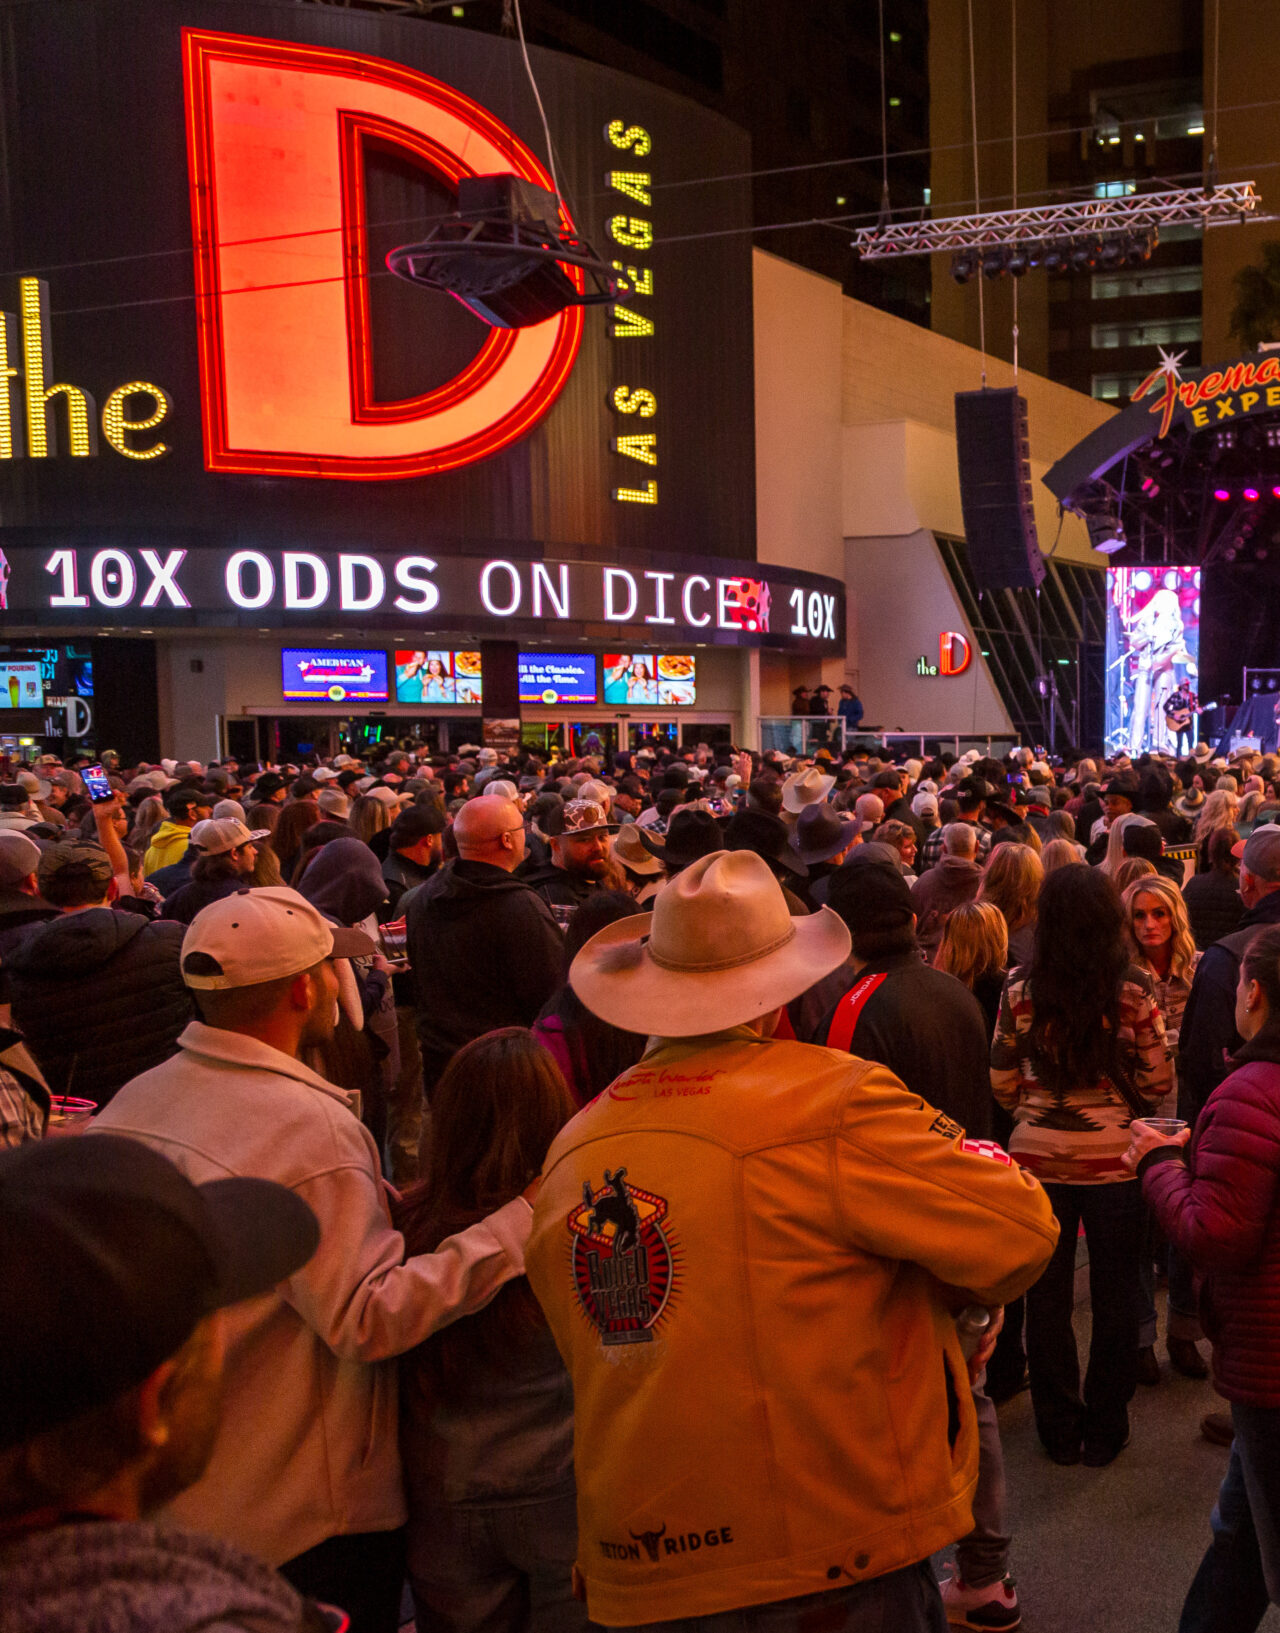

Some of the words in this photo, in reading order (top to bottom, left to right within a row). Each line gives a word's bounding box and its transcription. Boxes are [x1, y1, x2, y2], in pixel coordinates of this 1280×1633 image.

[606, 119, 655, 337] VEGAS
[0, 277, 169, 460] the
[181, 26, 585, 481] D
[612, 384, 658, 505] LAS
[45, 548, 192, 608] 10X
[225, 550, 441, 614] ODDS
[480, 558, 571, 619] ON
[789, 587, 836, 640] 10X
[309, 658, 364, 667] AMERICAN
[916, 656, 937, 676] the
[940, 631, 971, 675] D
[45, 716, 63, 737] the
[66, 696, 92, 738] D
[654, 1088, 673, 1098] LAS
[676, 1086, 712, 1098] VEGAS
[585, 1245, 651, 1292] RODEO
[591, 1286, 654, 1326] VEGAS
[599, 1540, 641, 1561] TETON
[663, 1526, 734, 1555] RIDGE
